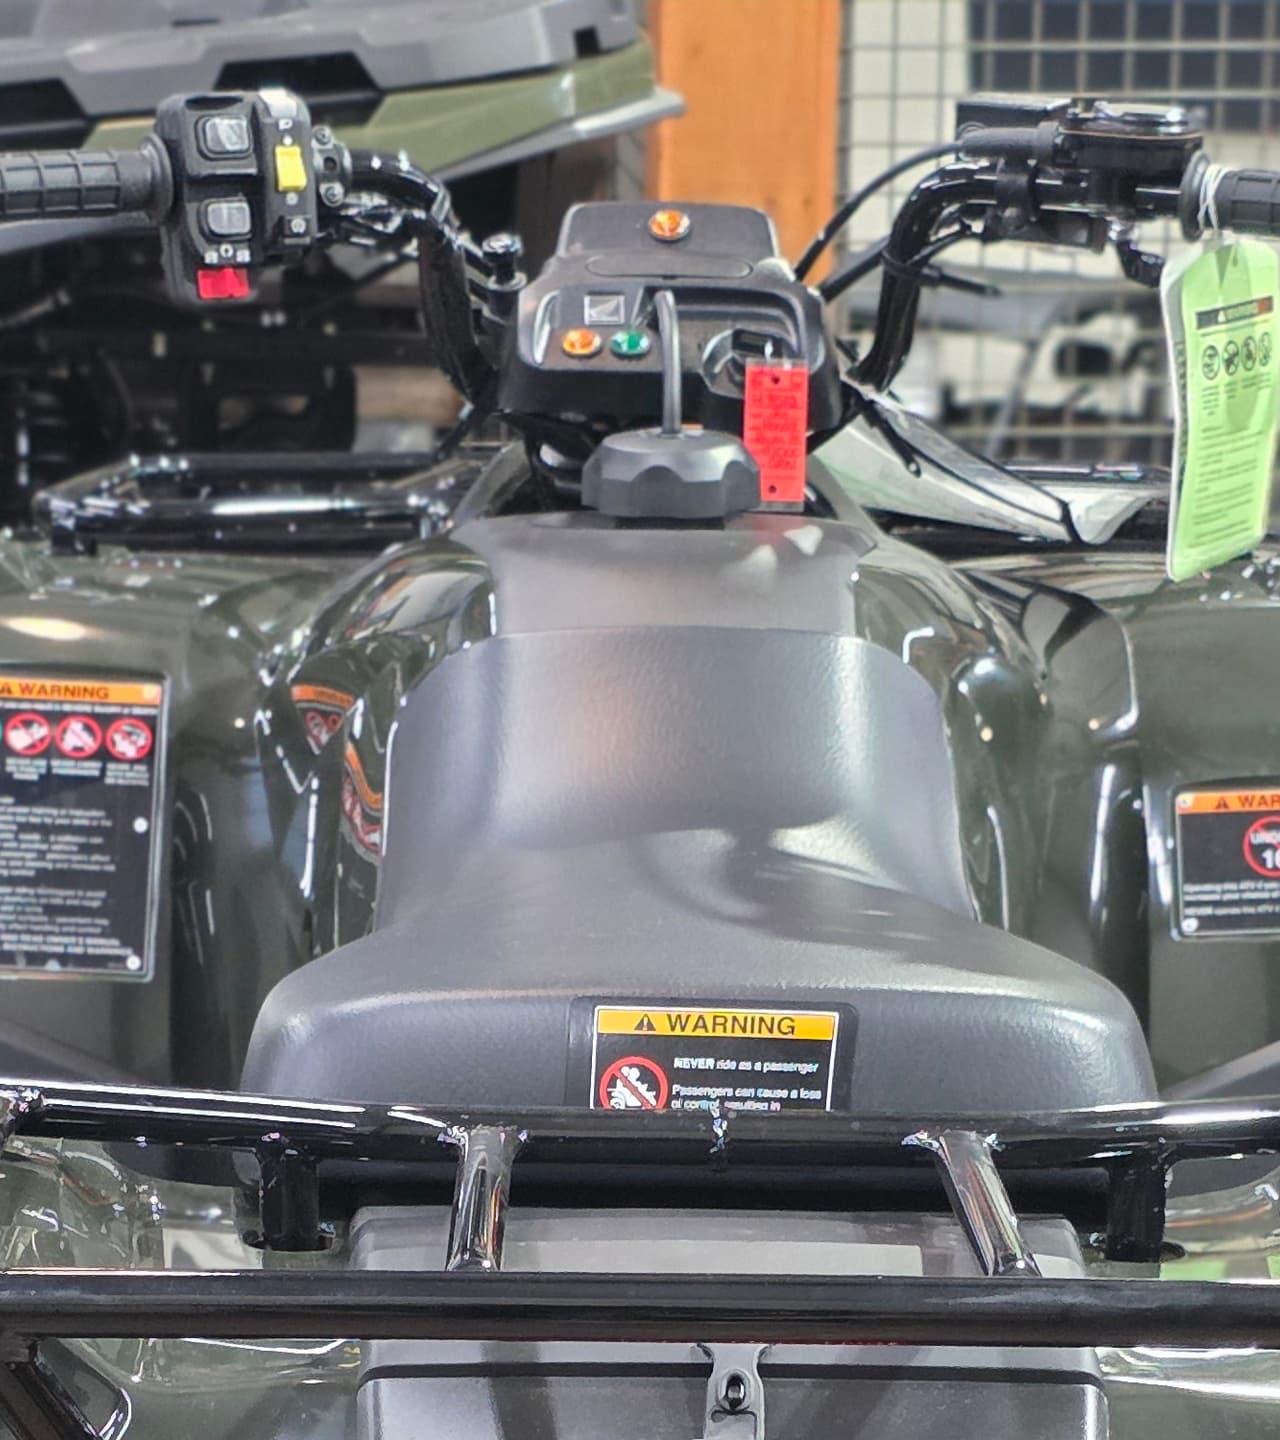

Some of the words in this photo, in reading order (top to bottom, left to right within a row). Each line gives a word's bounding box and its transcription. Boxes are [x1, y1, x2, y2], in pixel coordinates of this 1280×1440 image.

[19, 682, 109, 700] WARNING
[667, 1013, 796, 1036] WARNING
[673, 1057, 715, 1070] NEVER
[716, 1059, 737, 1070] ride
[738, 1061, 752, 1071] as
[754, 1061, 761, 1071] a
[763, 1062, 820, 1075] passenger
[672, 1084, 733, 1099] Passengers
[735, 1087, 754, 1098] can
[757, 1087, 788, 1099] cause
[790, 1088, 798, 1099] a
[800, 1087, 821, 1100] loss
